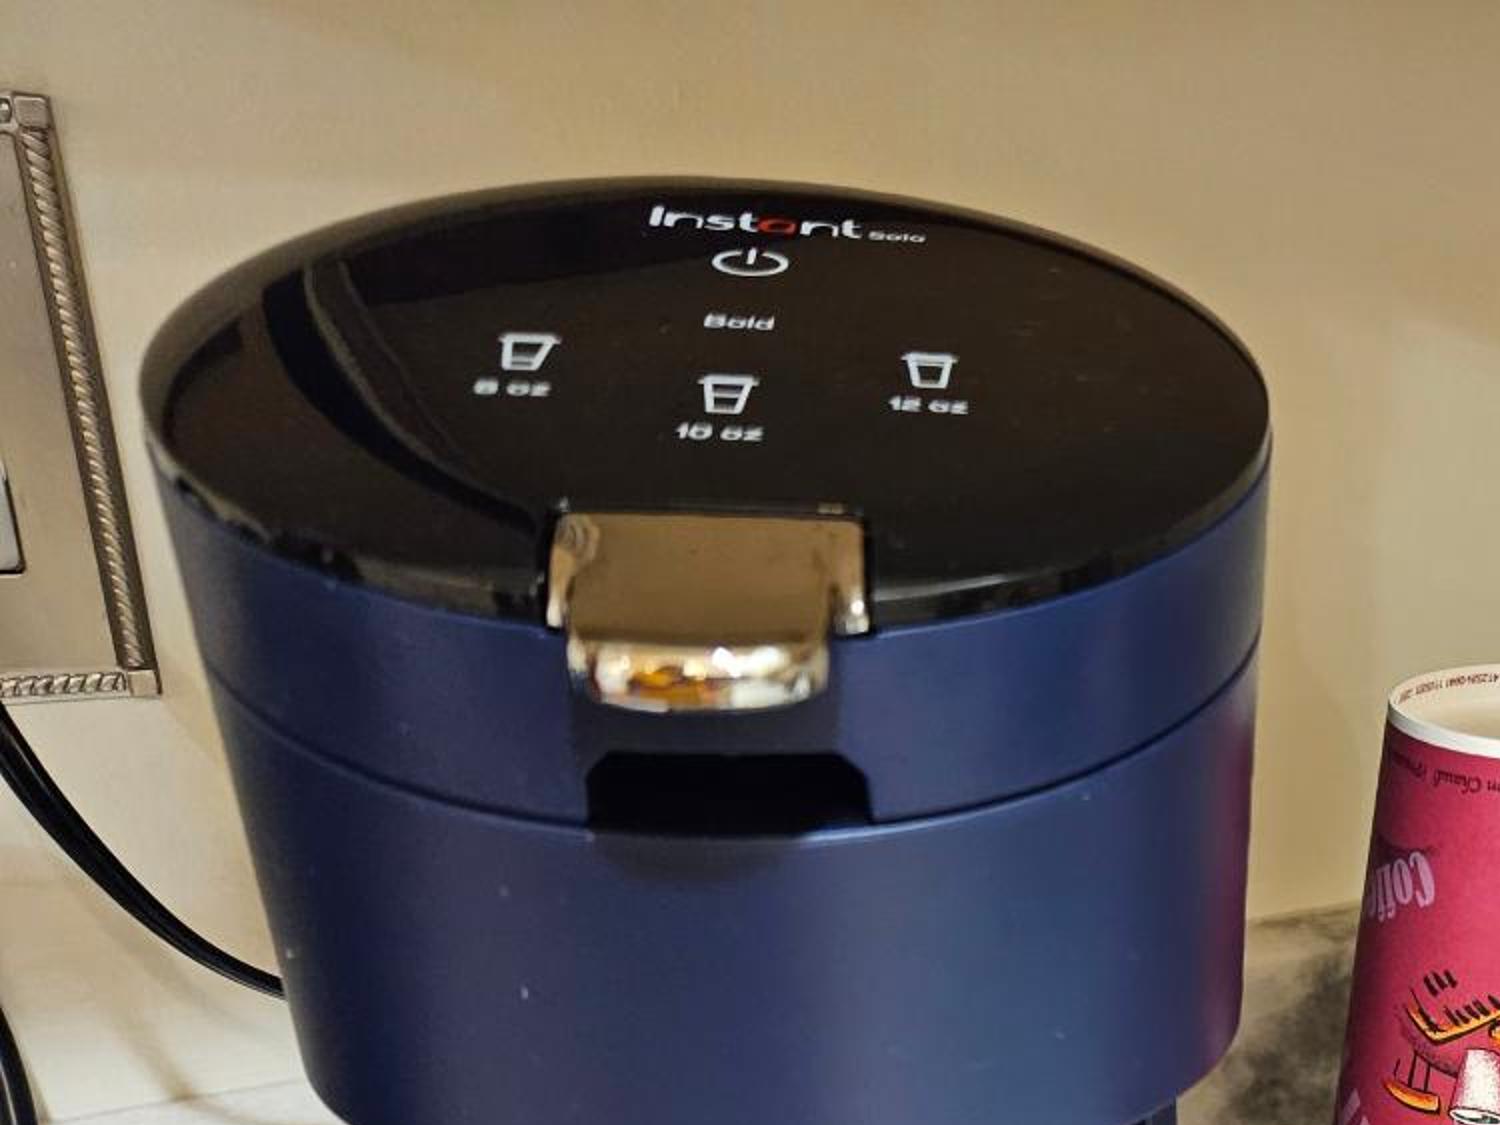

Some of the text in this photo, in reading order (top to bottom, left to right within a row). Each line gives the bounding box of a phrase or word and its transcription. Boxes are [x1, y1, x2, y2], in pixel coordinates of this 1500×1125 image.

[648, 205, 927, 243] Instant Solo
[703, 313, 776, 332] Bold
[506, 381, 551, 397] oz
[889, 396, 968, 415] 12 oz
[676, 423, 764, 442] 10 oz
